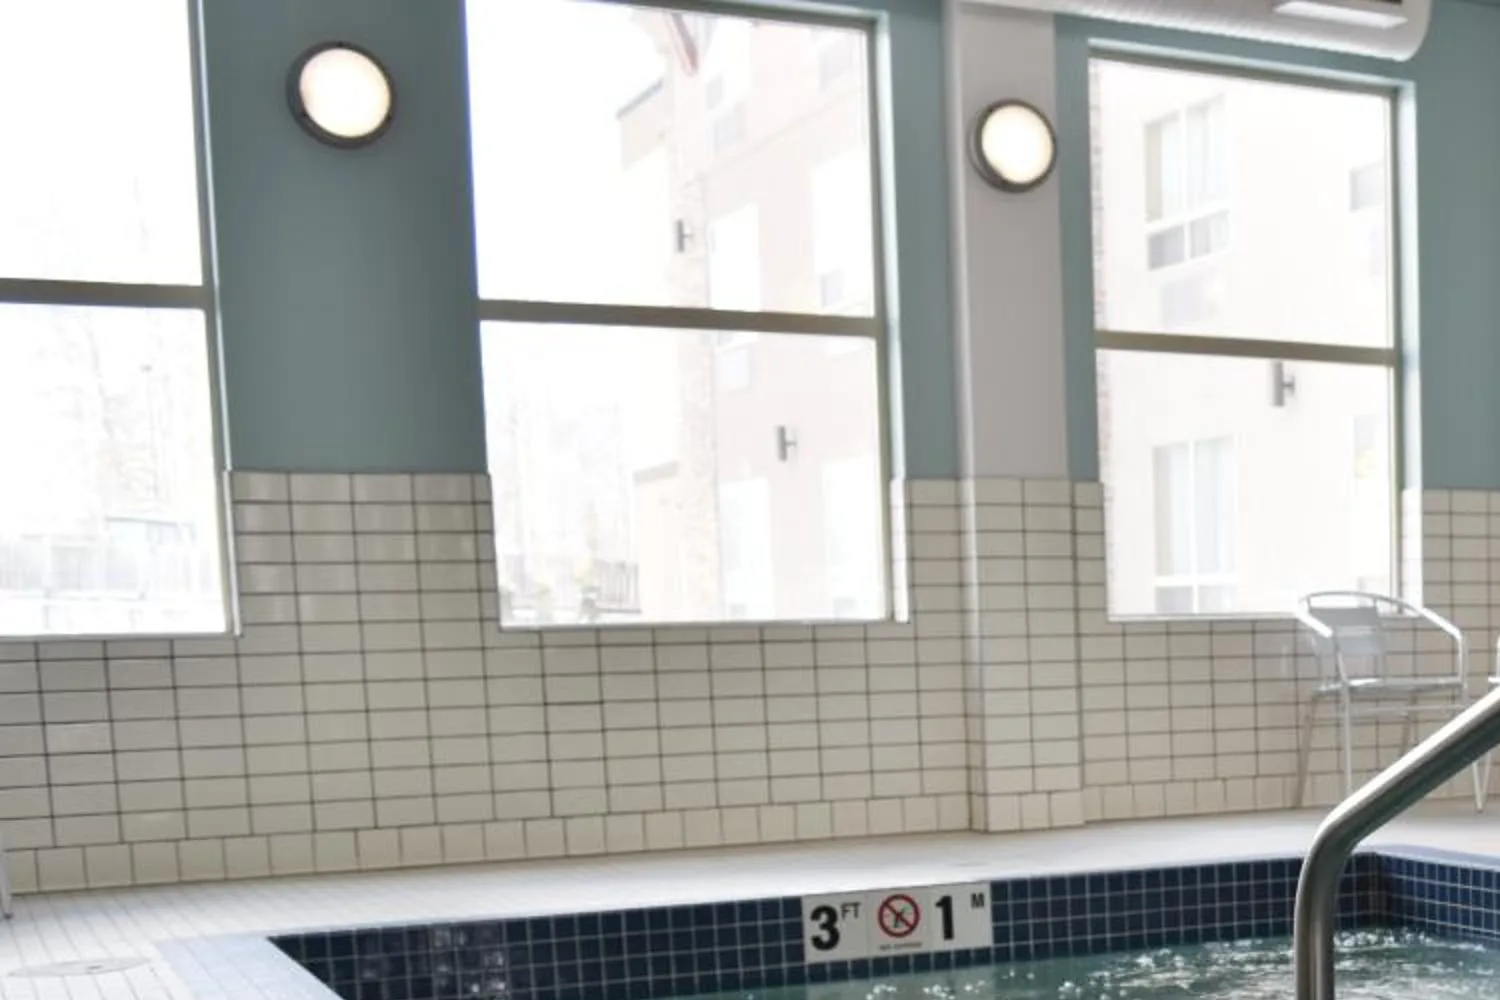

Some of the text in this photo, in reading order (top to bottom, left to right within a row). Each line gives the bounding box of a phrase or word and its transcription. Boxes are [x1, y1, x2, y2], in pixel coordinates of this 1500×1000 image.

[810, 902, 860, 951] 3 FT
[935, 892, 985, 940] 1 M
